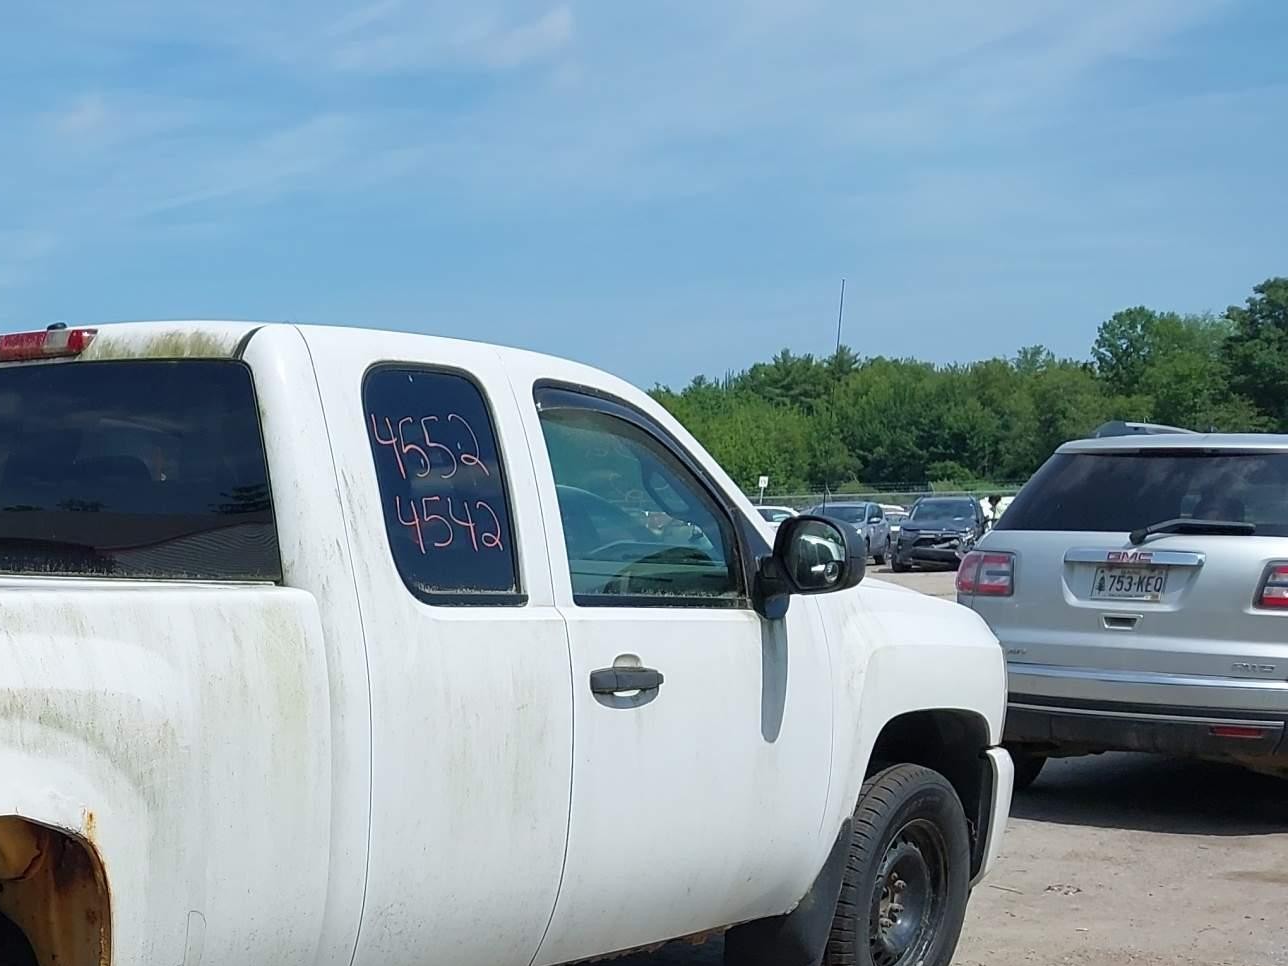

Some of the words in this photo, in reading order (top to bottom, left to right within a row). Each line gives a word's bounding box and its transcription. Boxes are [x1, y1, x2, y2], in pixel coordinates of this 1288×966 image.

[370, 413, 490, 480] 4552
[395, 495, 504, 555] 4542
[1107, 551, 1153, 562] GMC
